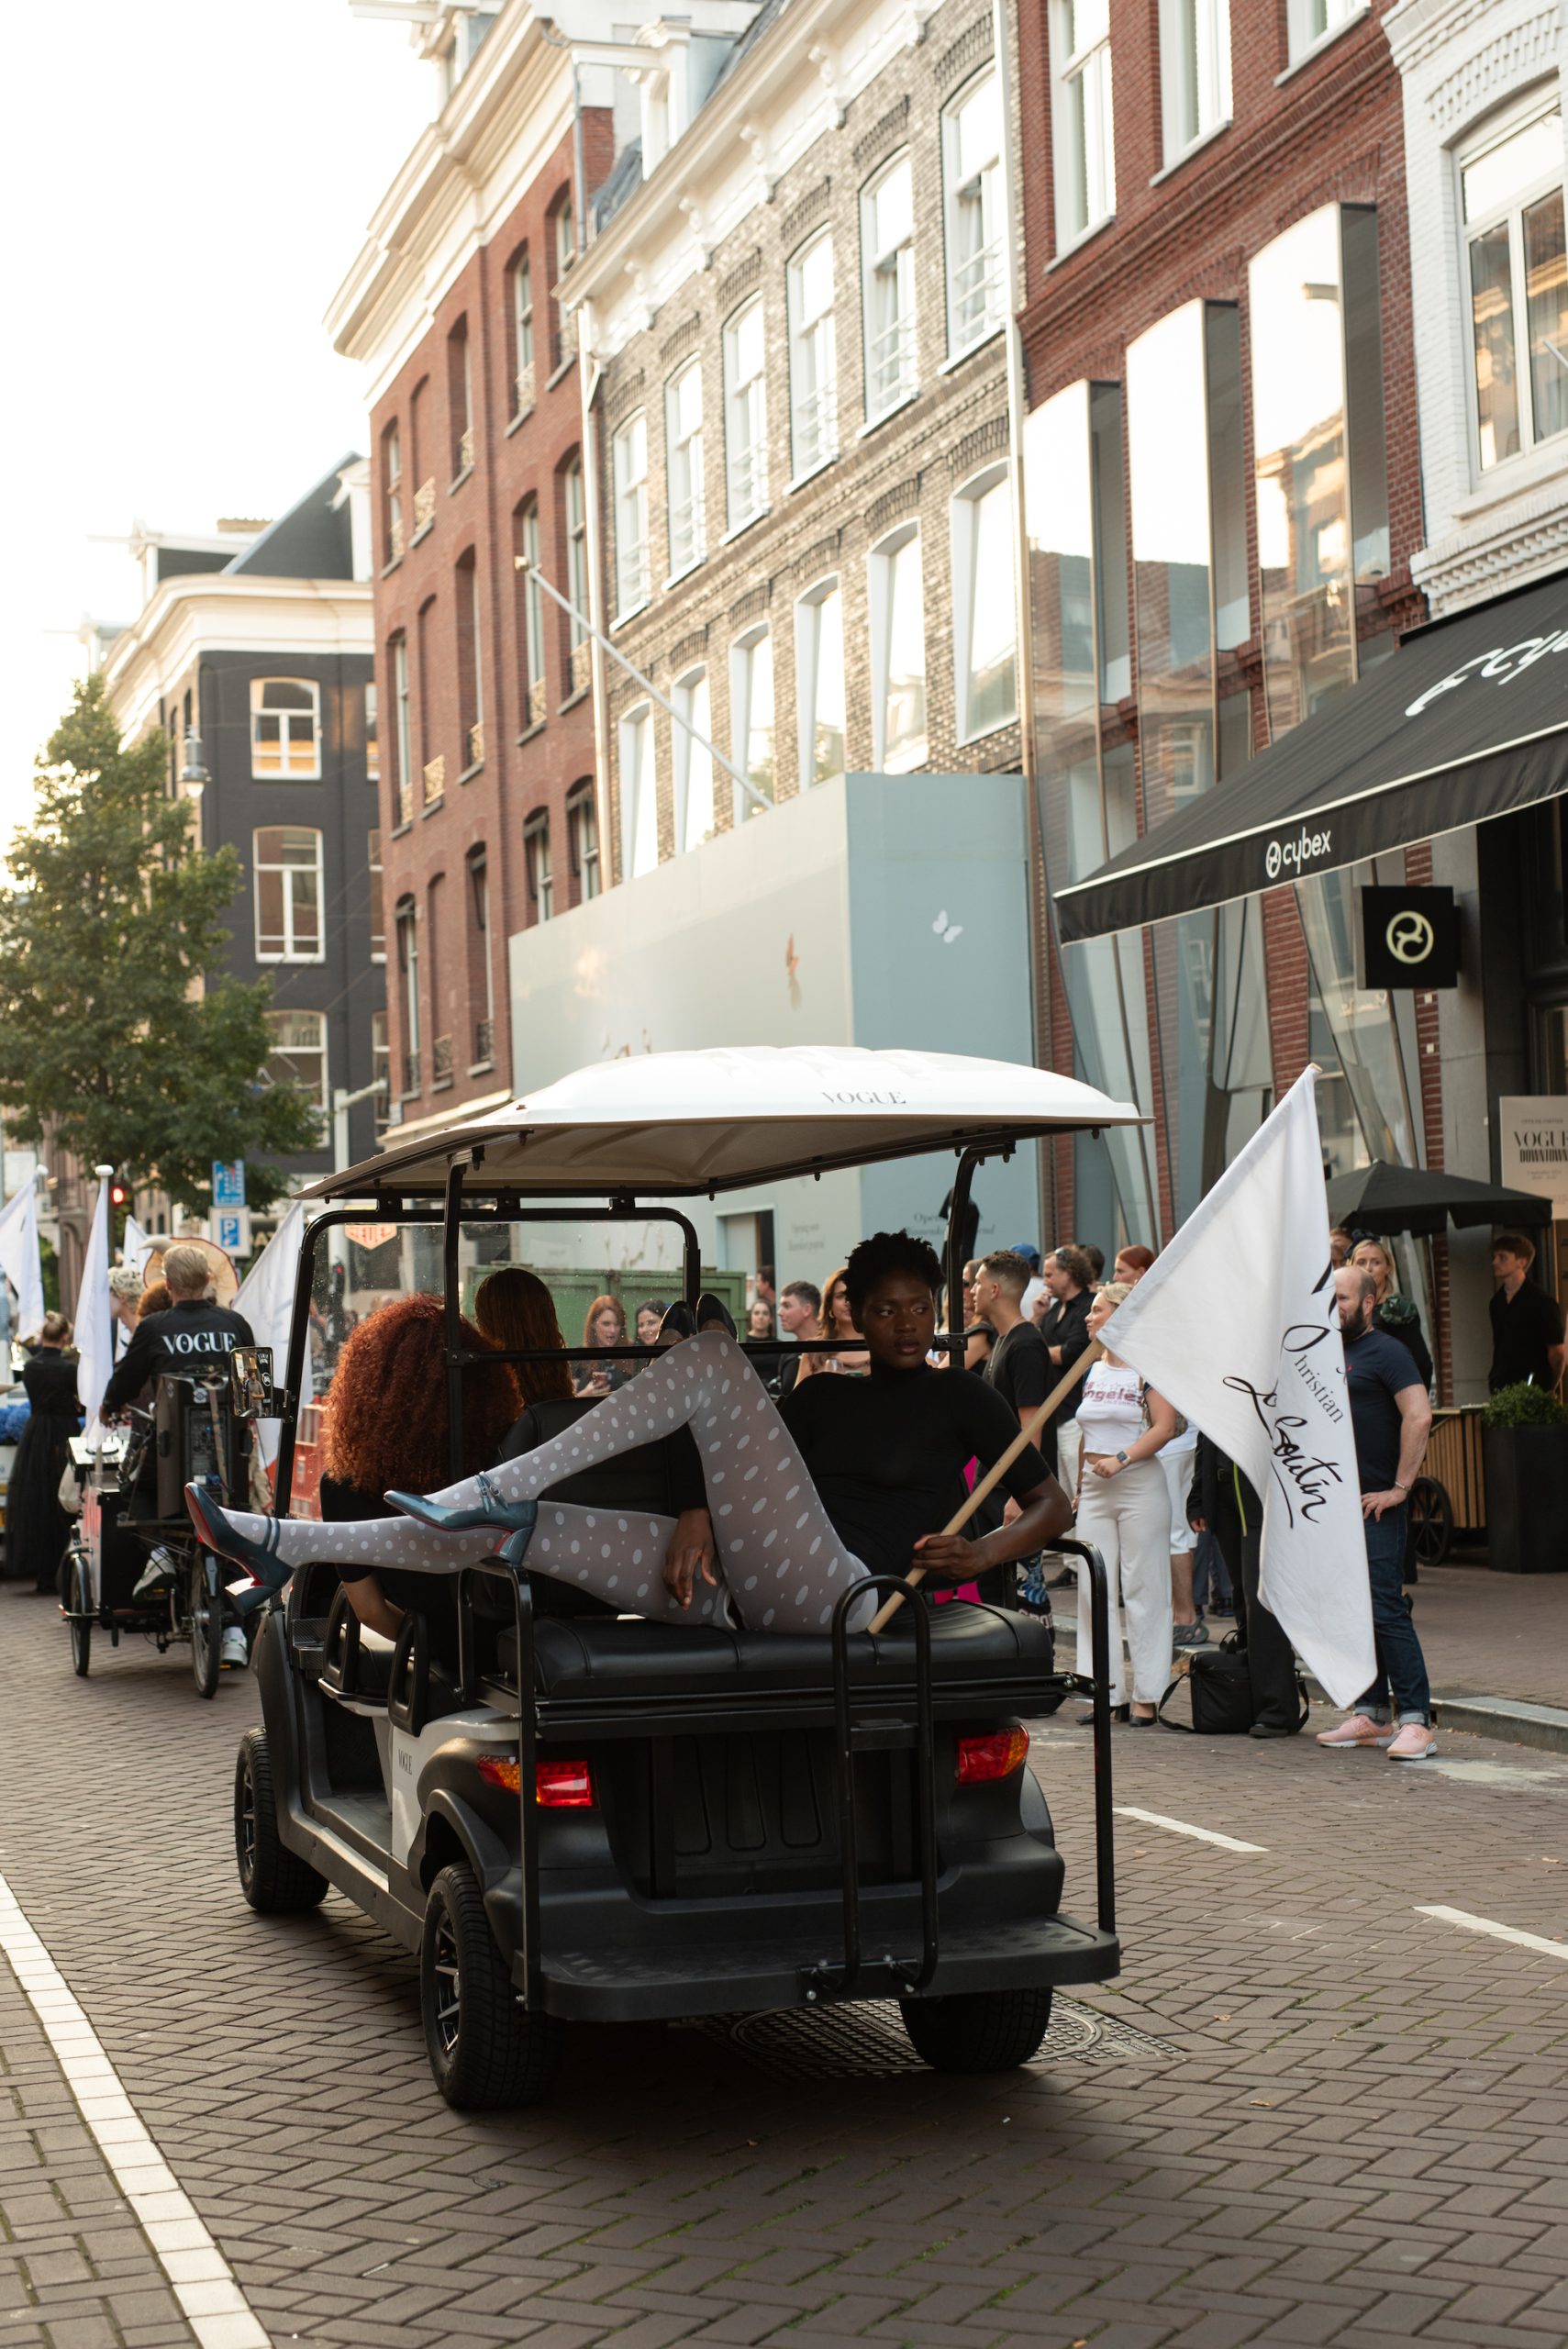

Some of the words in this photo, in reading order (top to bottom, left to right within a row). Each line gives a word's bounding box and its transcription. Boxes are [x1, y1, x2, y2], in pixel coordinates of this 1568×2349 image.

[1480, 629, 1568, 685] cy
[1283, 826, 1332, 874] cybex
[821, 1091, 906, 1104] VOGUE
[223, 1219, 236, 1236] P
[162, 1332, 236, 1354] VOGUE
[1222, 1374, 1342, 1529] Loboutin
[397, 1748, 413, 1776] VOGUE
